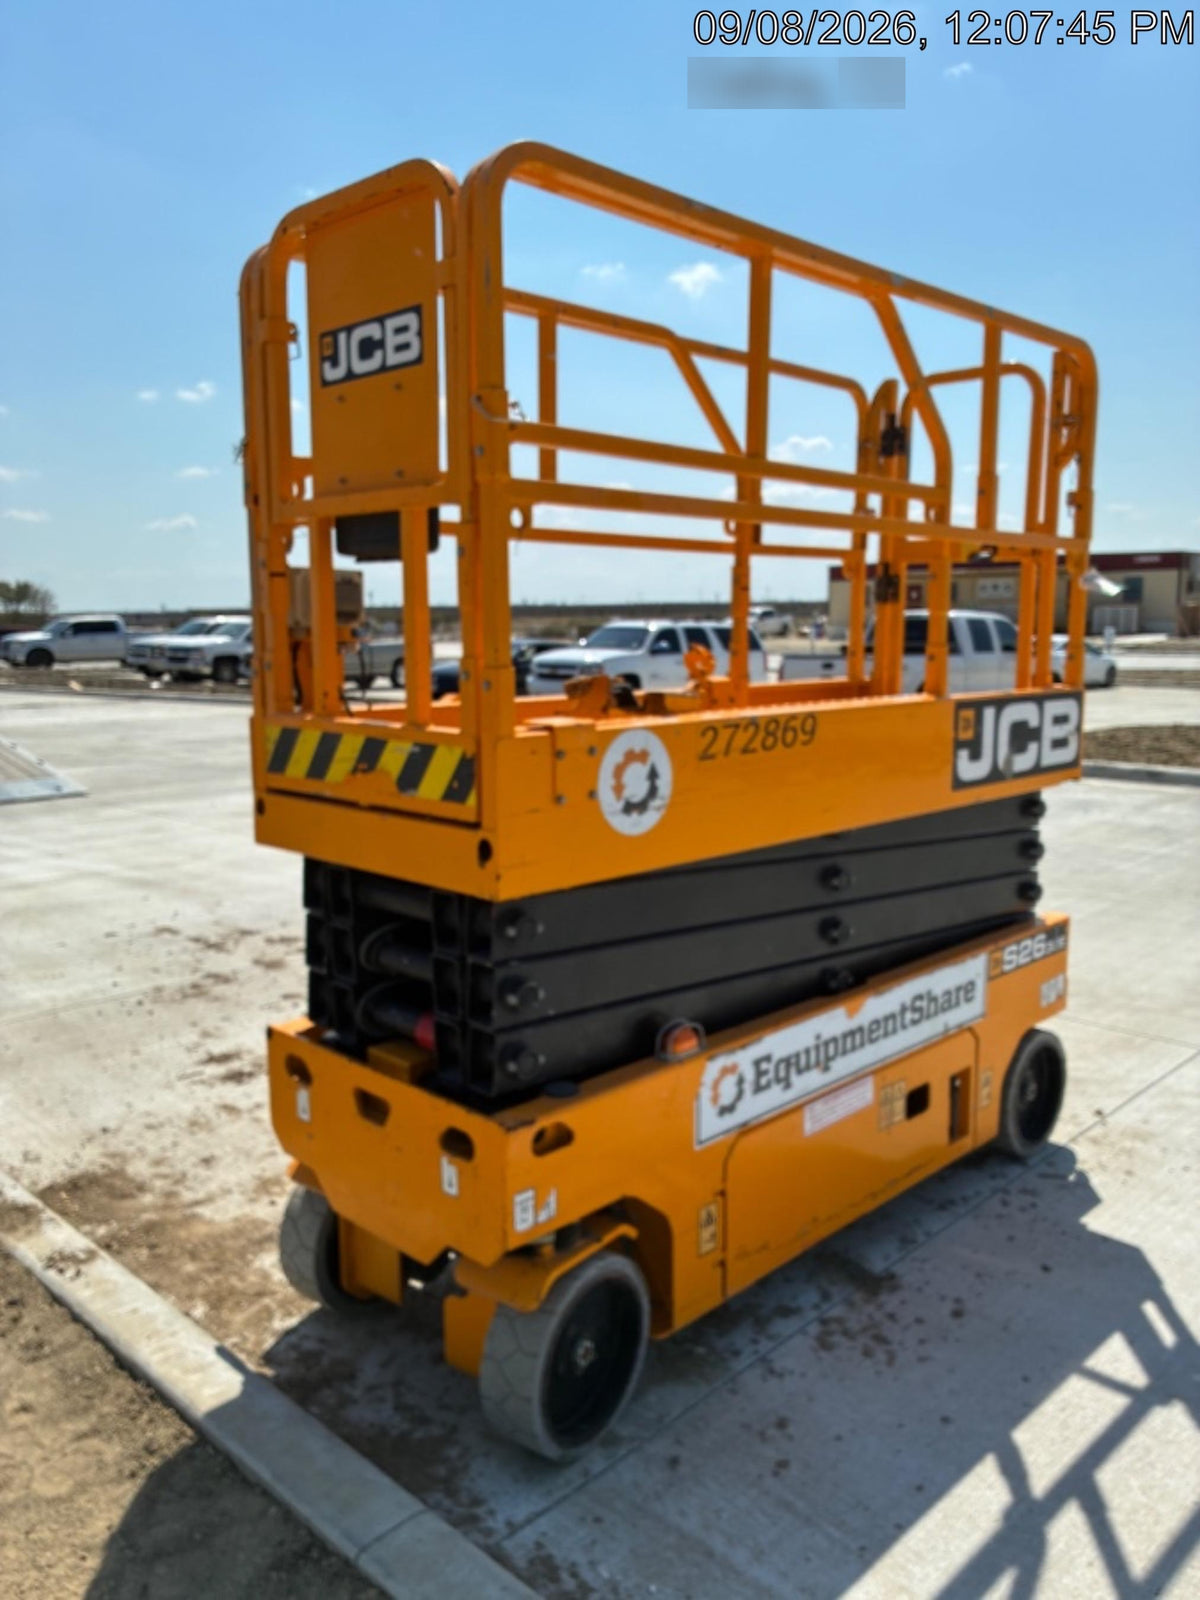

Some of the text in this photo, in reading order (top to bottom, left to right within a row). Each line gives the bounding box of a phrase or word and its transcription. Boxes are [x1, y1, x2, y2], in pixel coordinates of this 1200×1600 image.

[321, 311, 421, 383] JCB
[698, 711, 818, 762] 272869
[957, 698, 1079, 782] JCB
[752, 979, 976, 1096] EquipmentShare
